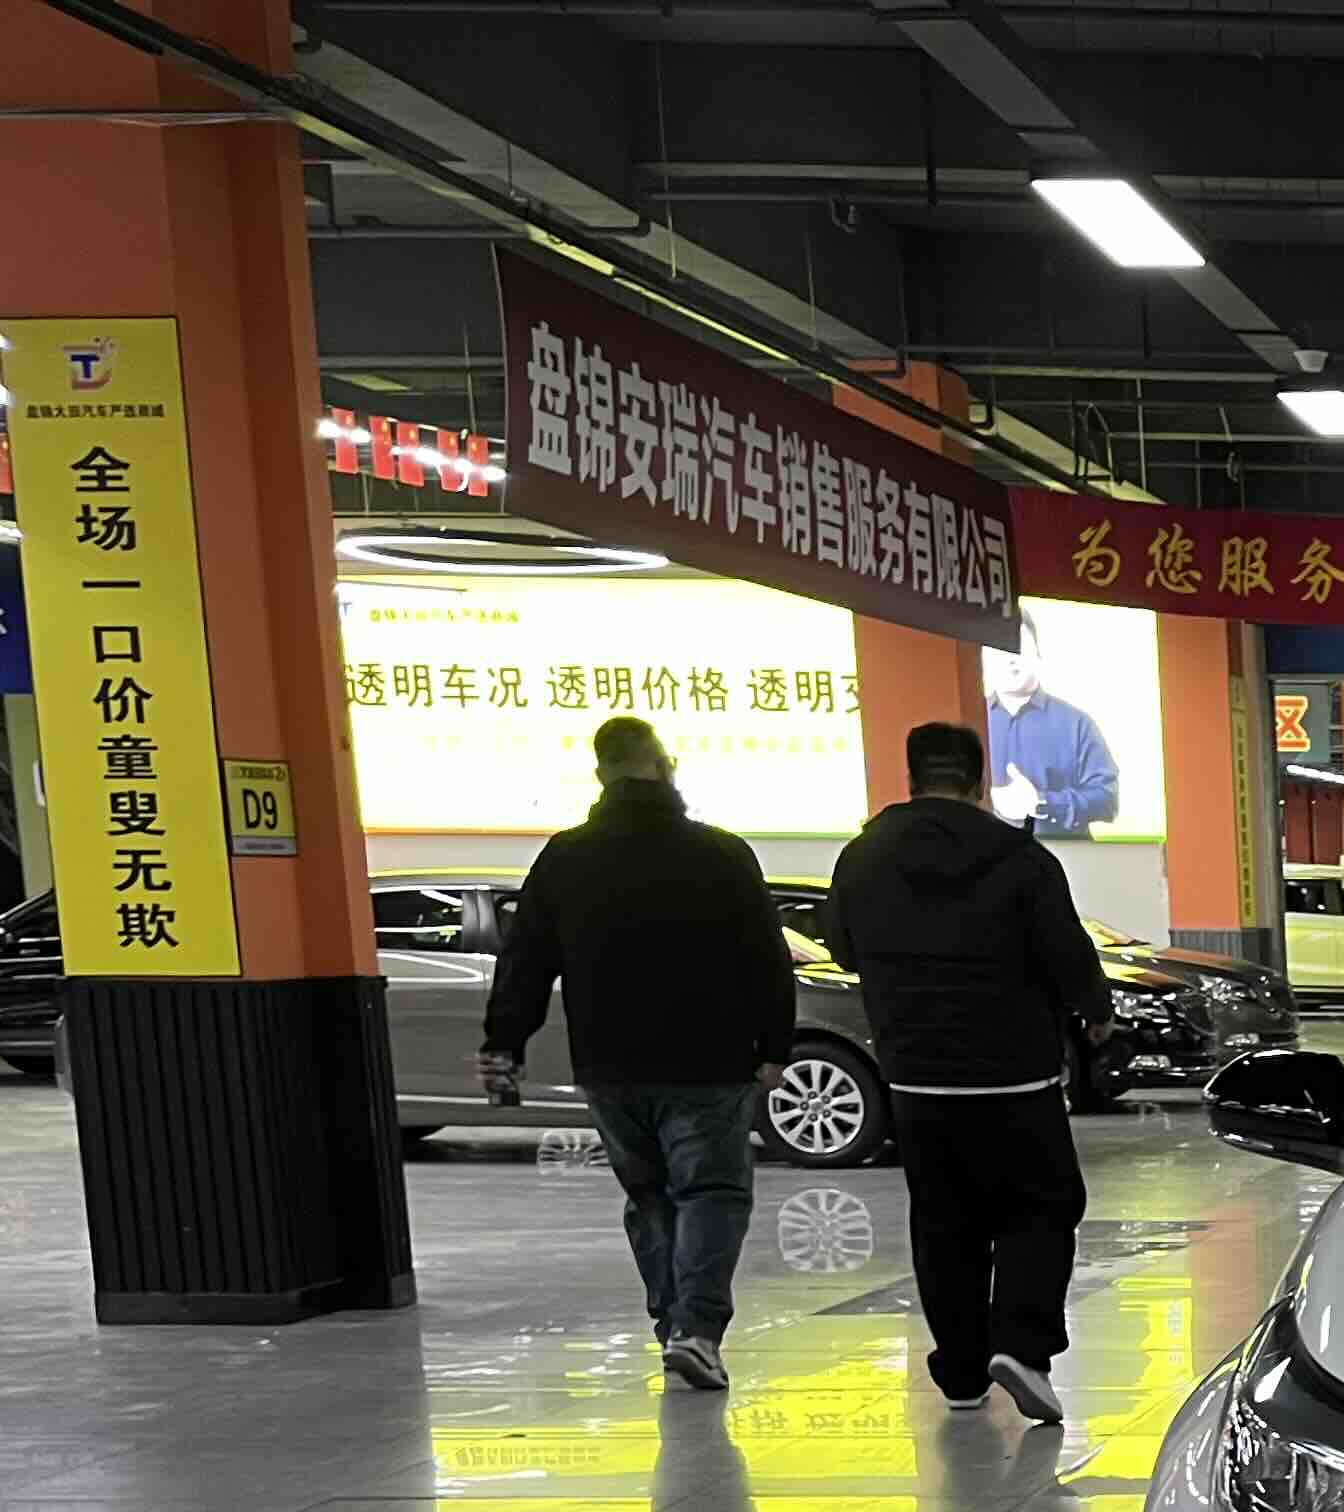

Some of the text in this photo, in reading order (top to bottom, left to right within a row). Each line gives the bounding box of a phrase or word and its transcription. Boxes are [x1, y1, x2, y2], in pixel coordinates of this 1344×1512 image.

[527, 320, 1013, 618] 盘锦安瑞汽车销售服务有限公司
[71, 446, 180, 948] 全场一口价童叟无欺
[344, 663, 529, 709] 透明车况
[545, 665, 729, 711] 透明价格
[242, 788, 278, 830] D9
